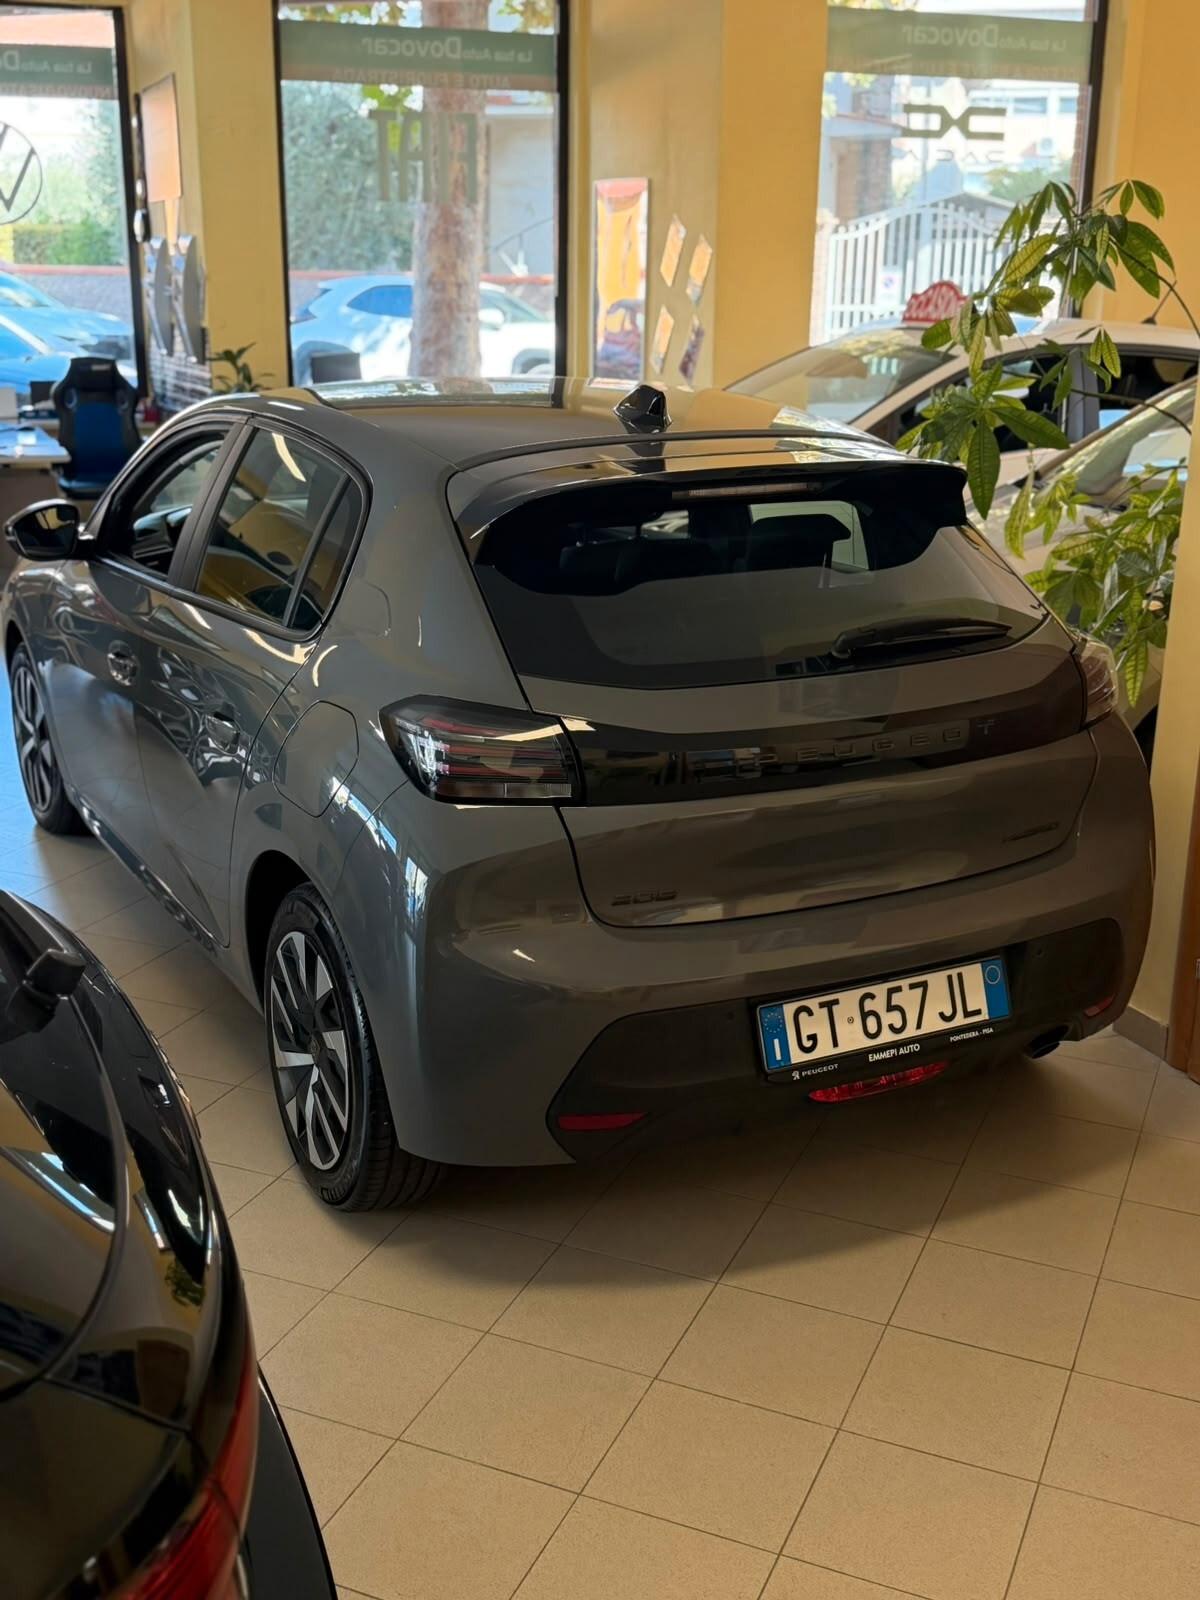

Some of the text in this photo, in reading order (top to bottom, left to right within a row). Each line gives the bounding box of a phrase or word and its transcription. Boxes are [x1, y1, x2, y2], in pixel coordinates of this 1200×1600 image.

[792, 998, 840, 1054] GT
[858, 980, 929, 1040] 657
[938, 971, 982, 1023] JL
[868, 1043, 921, 1062] EMMEPI AUTO
[801, 1063, 839, 1077] PEUGEOT
